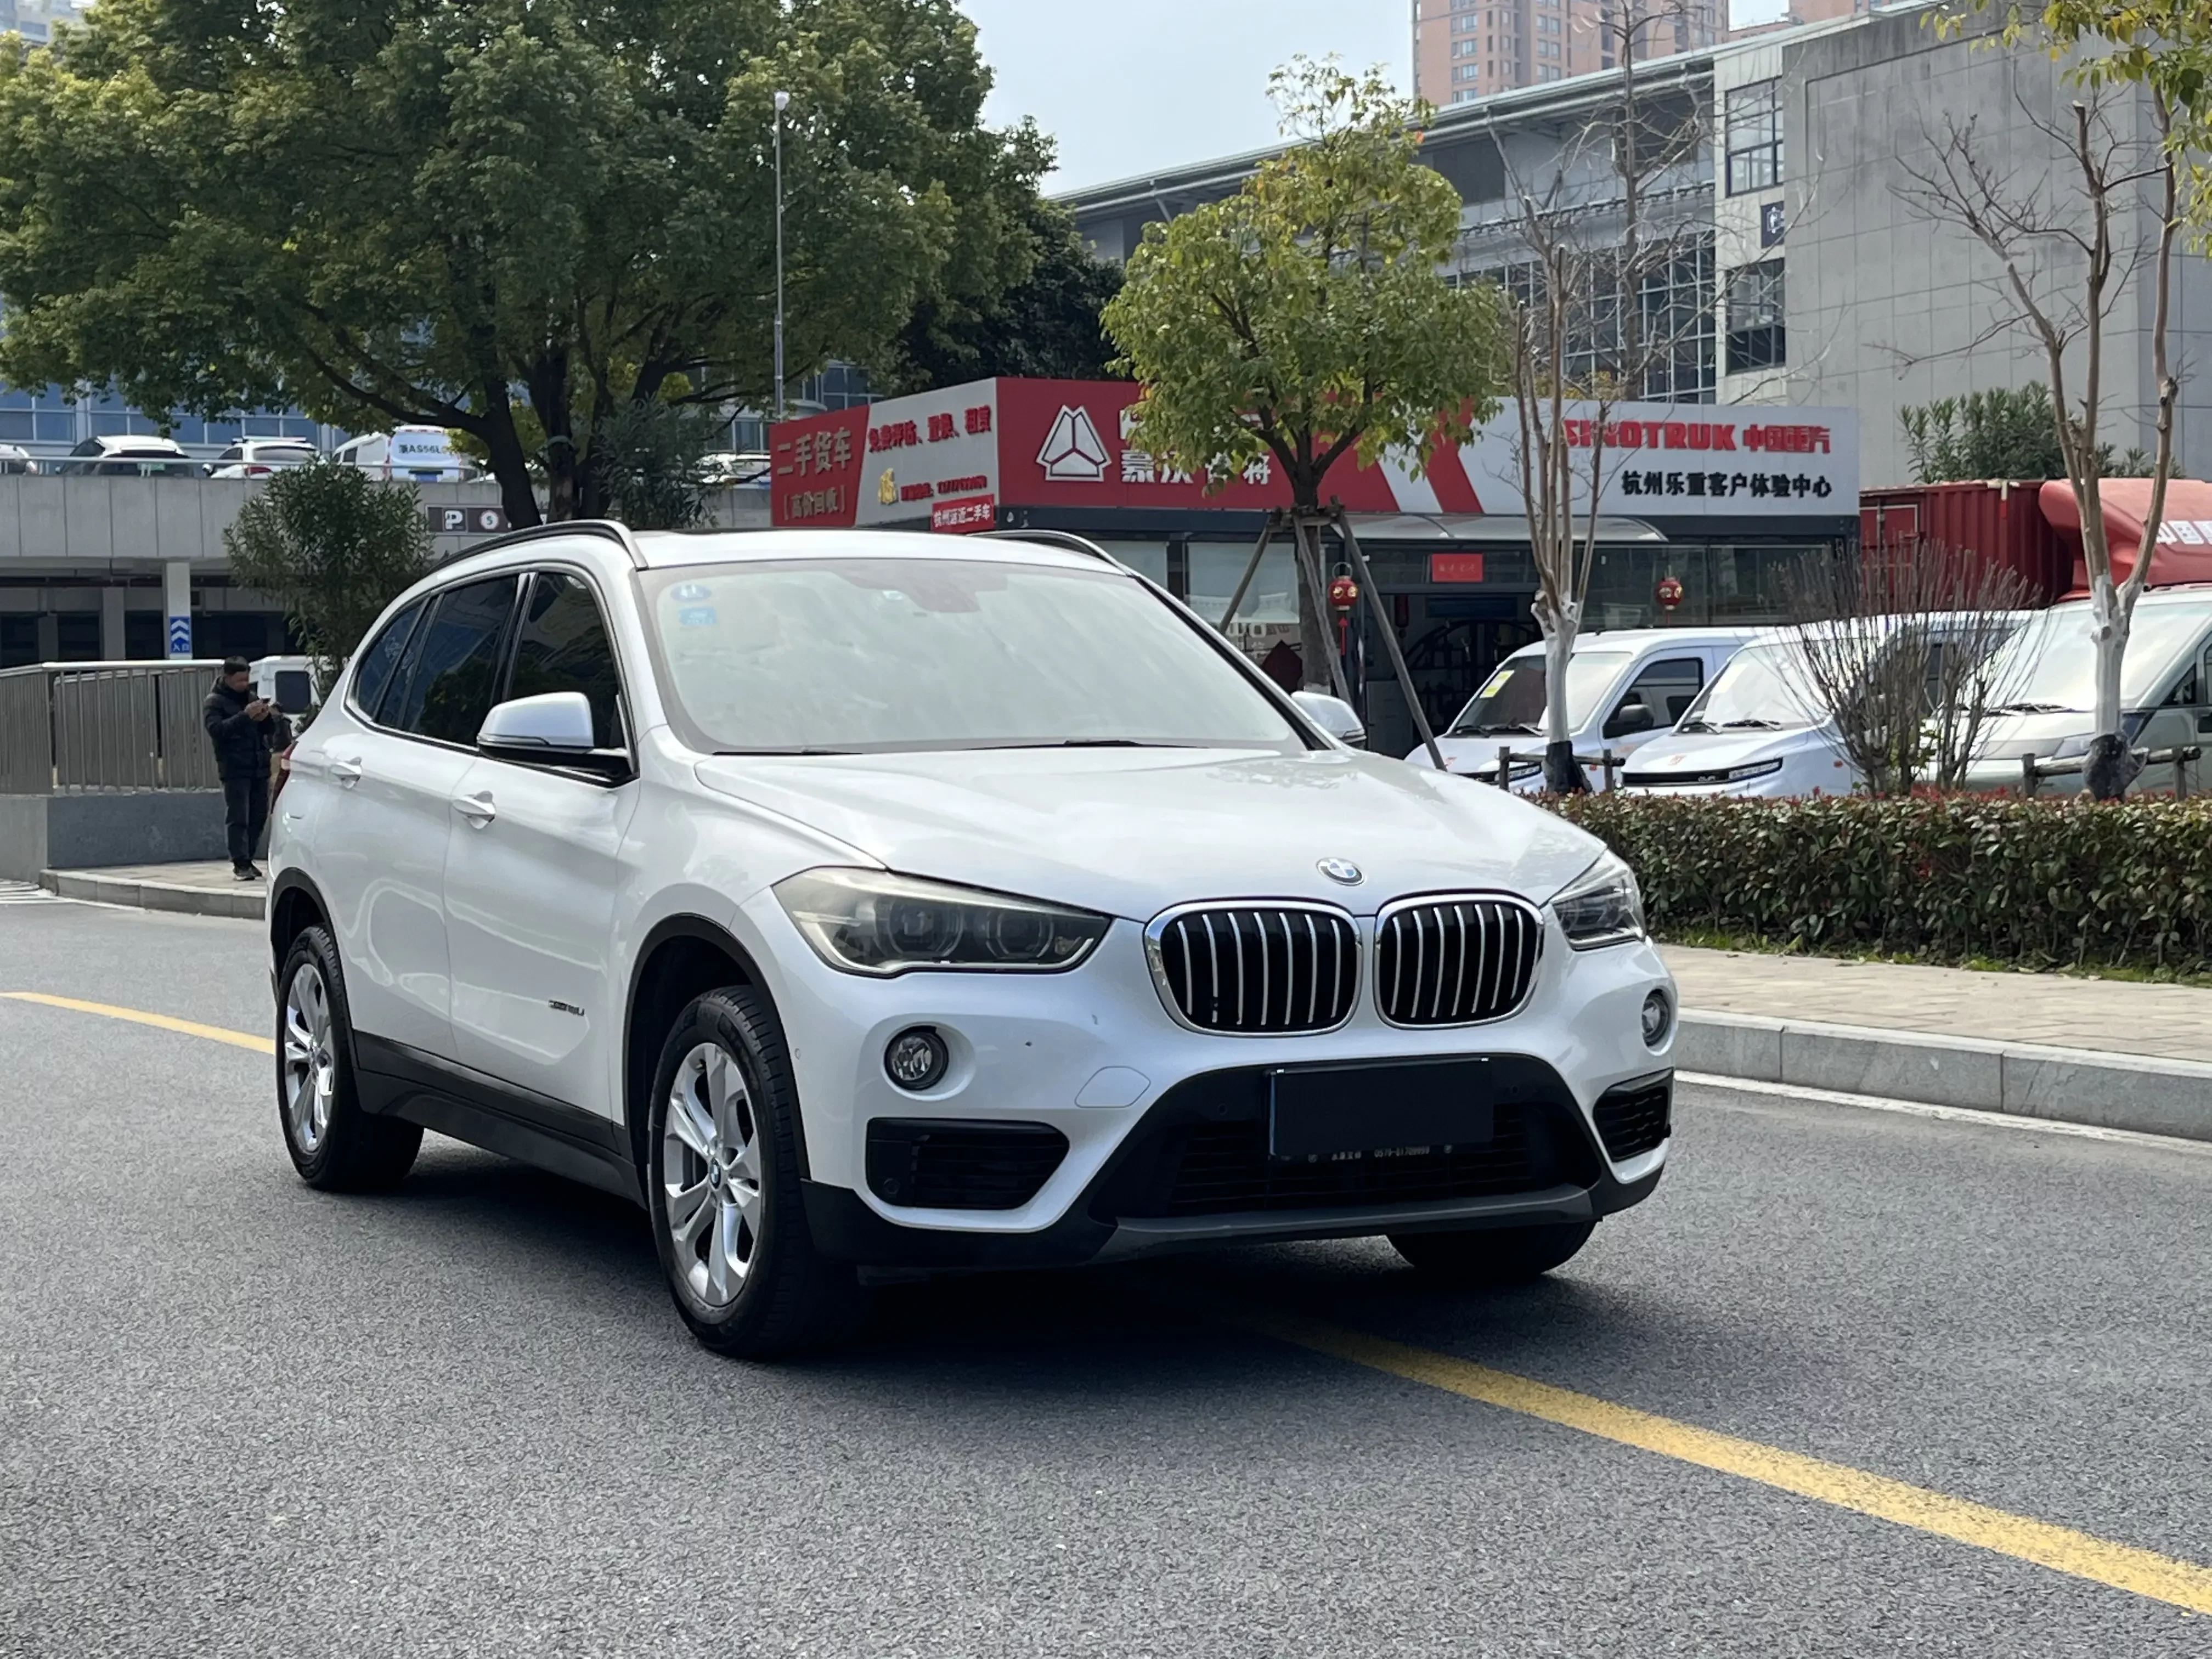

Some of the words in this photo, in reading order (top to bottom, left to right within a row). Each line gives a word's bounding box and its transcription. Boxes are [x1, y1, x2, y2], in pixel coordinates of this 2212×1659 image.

[777, 426, 851, 477] 二手货车
[1564, 419, 1737, 451] SINOTRUK
[1743, 424, 1831, 454] 中国重汽
[1622, 470, 1832, 498] 杭州乐重客户体验中心
